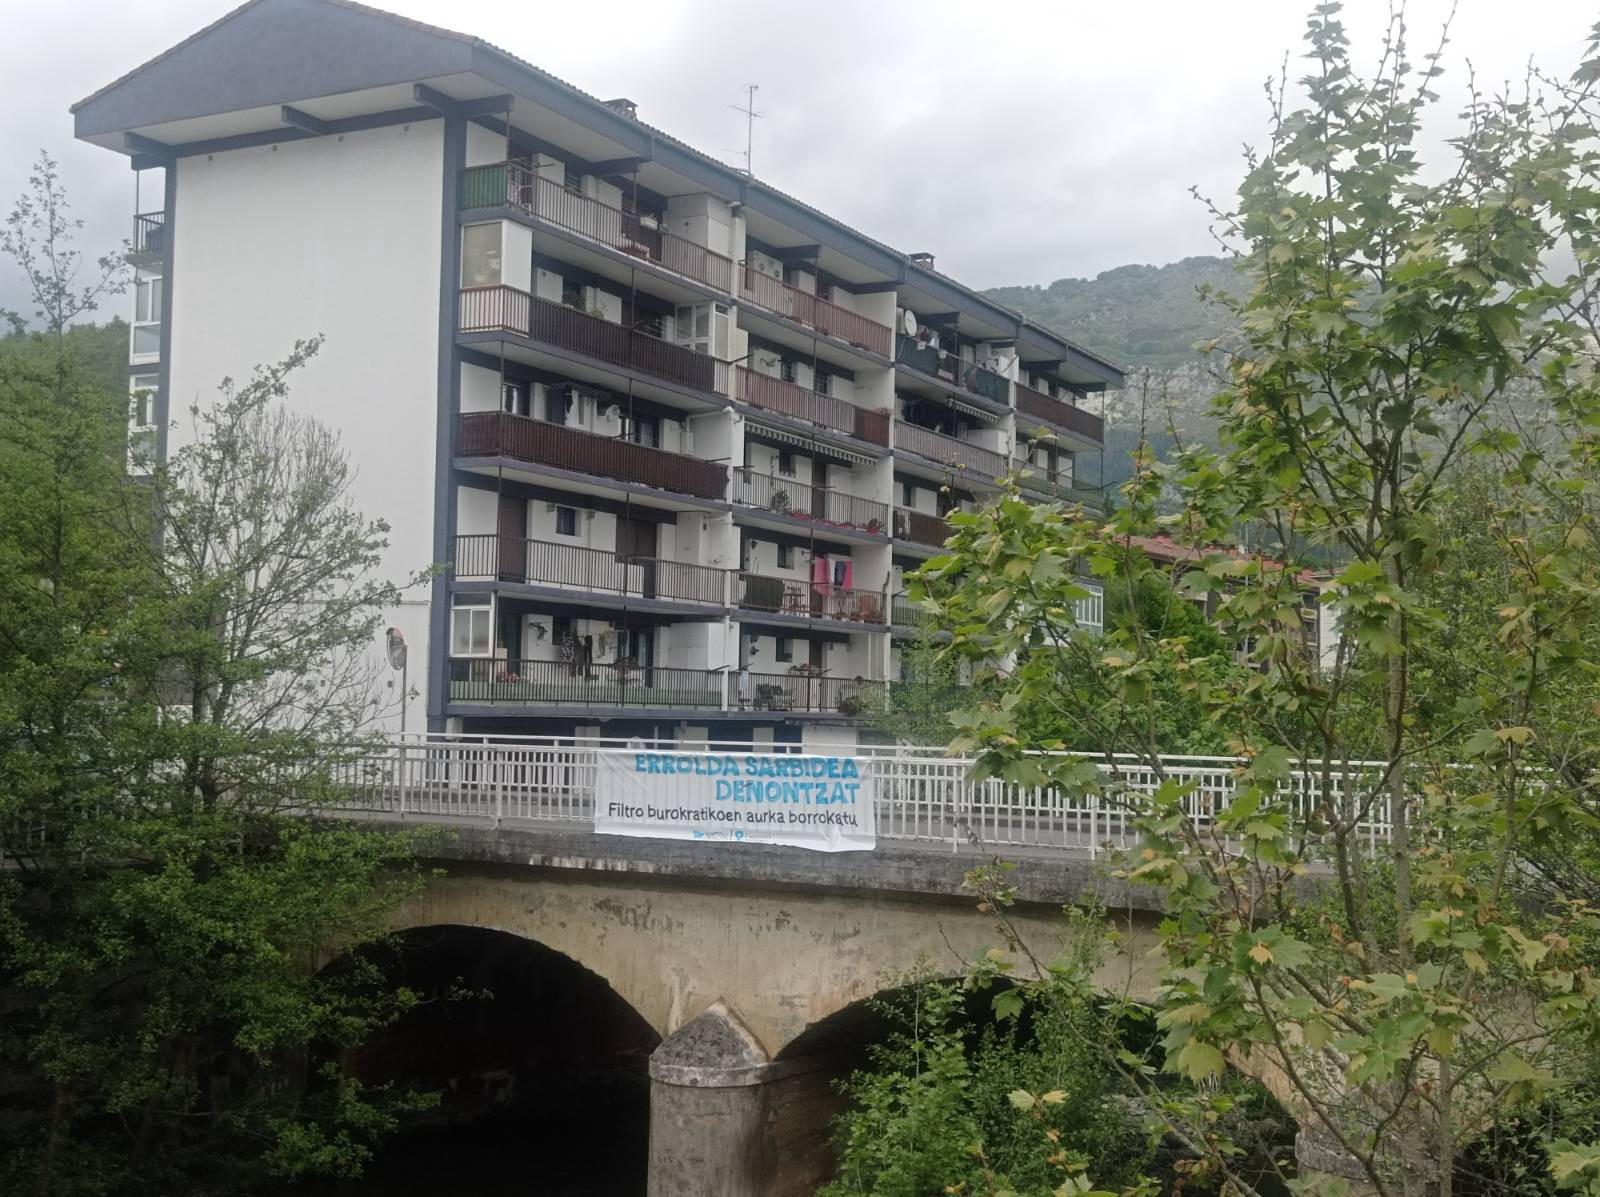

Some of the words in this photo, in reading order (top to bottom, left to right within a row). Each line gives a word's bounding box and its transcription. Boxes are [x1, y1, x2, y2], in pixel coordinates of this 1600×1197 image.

[635, 754, 739, 775] ERROLDA
[745, 756, 859, 778] SARBIDEA
[716, 780, 859, 804] DENONTZAT
[608, 802, 644, 818] Filtro
[648, 805, 742, 822] burokratikoen
[747, 809, 786, 823] aurka
[789, 810, 858, 827] borrokatu
